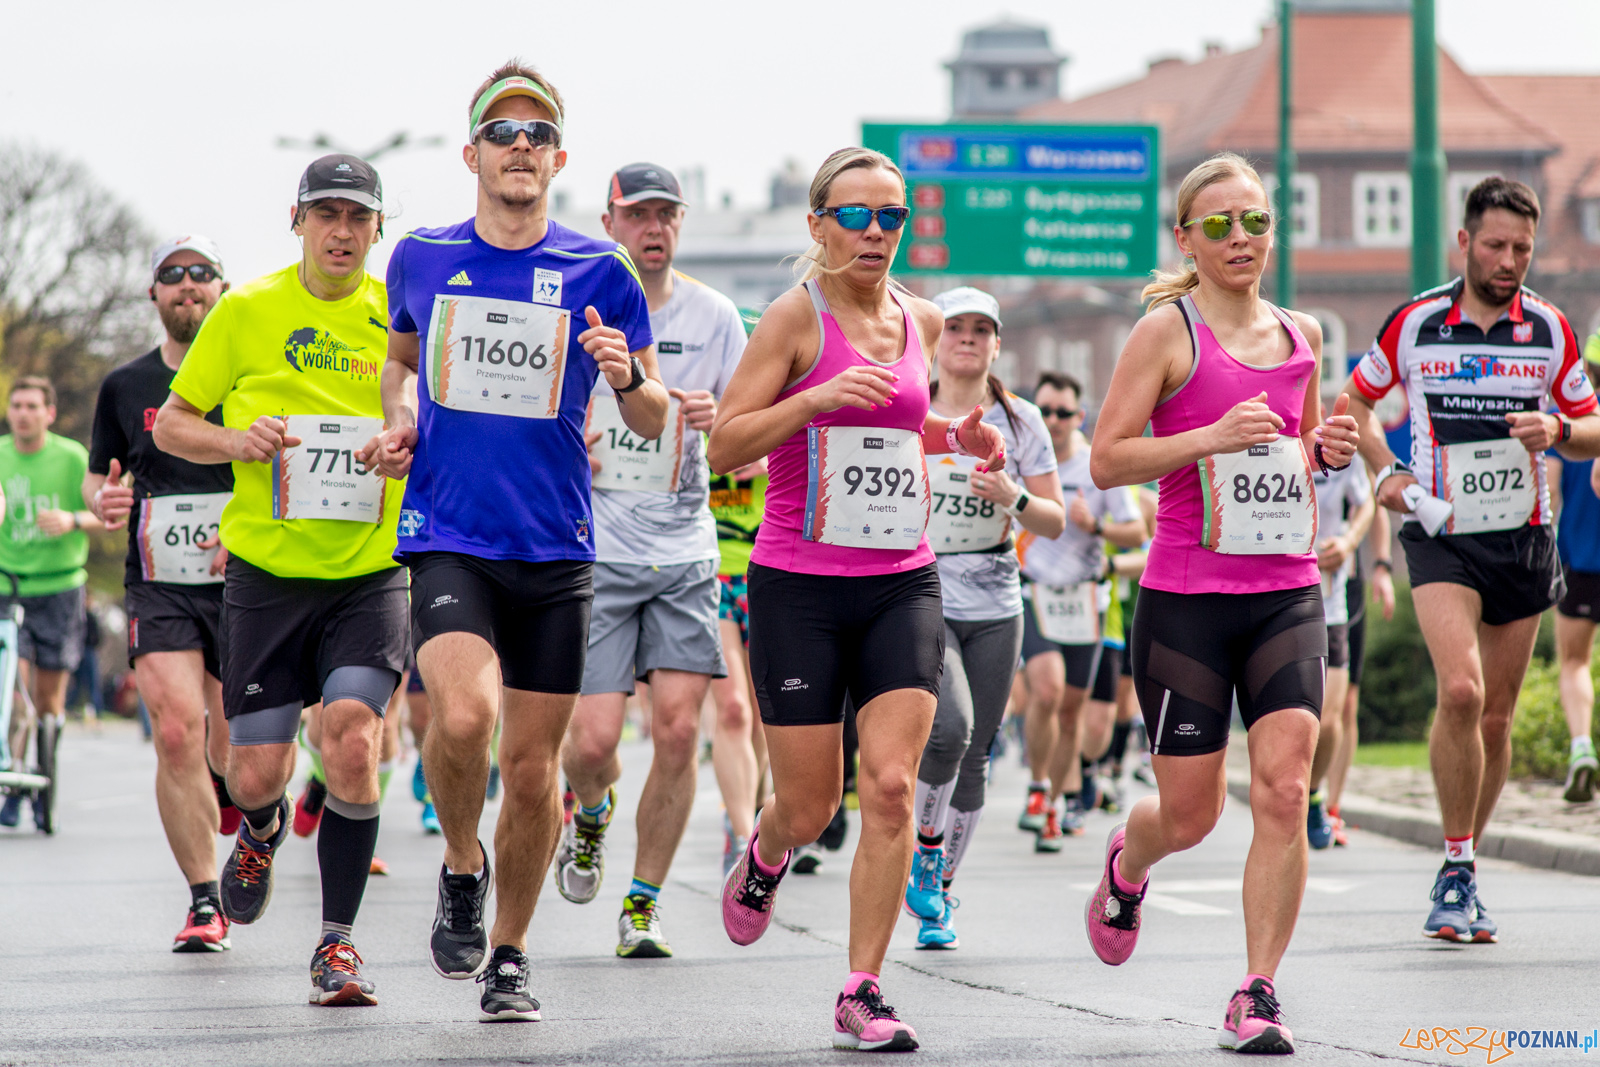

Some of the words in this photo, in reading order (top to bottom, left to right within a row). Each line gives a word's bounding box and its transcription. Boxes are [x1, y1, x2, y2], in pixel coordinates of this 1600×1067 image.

[461, 336, 547, 370] 11606
[351, 374, 378, 382] 2017
[476, 369, 527, 382] Przemysław
[1420, 361, 1455, 375] KRI
[1477, 358, 1547, 378] TRANS
[321, 480, 357, 489] Mirosław
[844, 466, 916, 498] 9392
[1233, 473, 1302, 503] 8624
[1463, 468, 1524, 494] 8072
[867, 504, 897, 512] Anetta
[933, 492, 995, 518] 7358
[1251, 510, 1291, 520] Agnieszka
